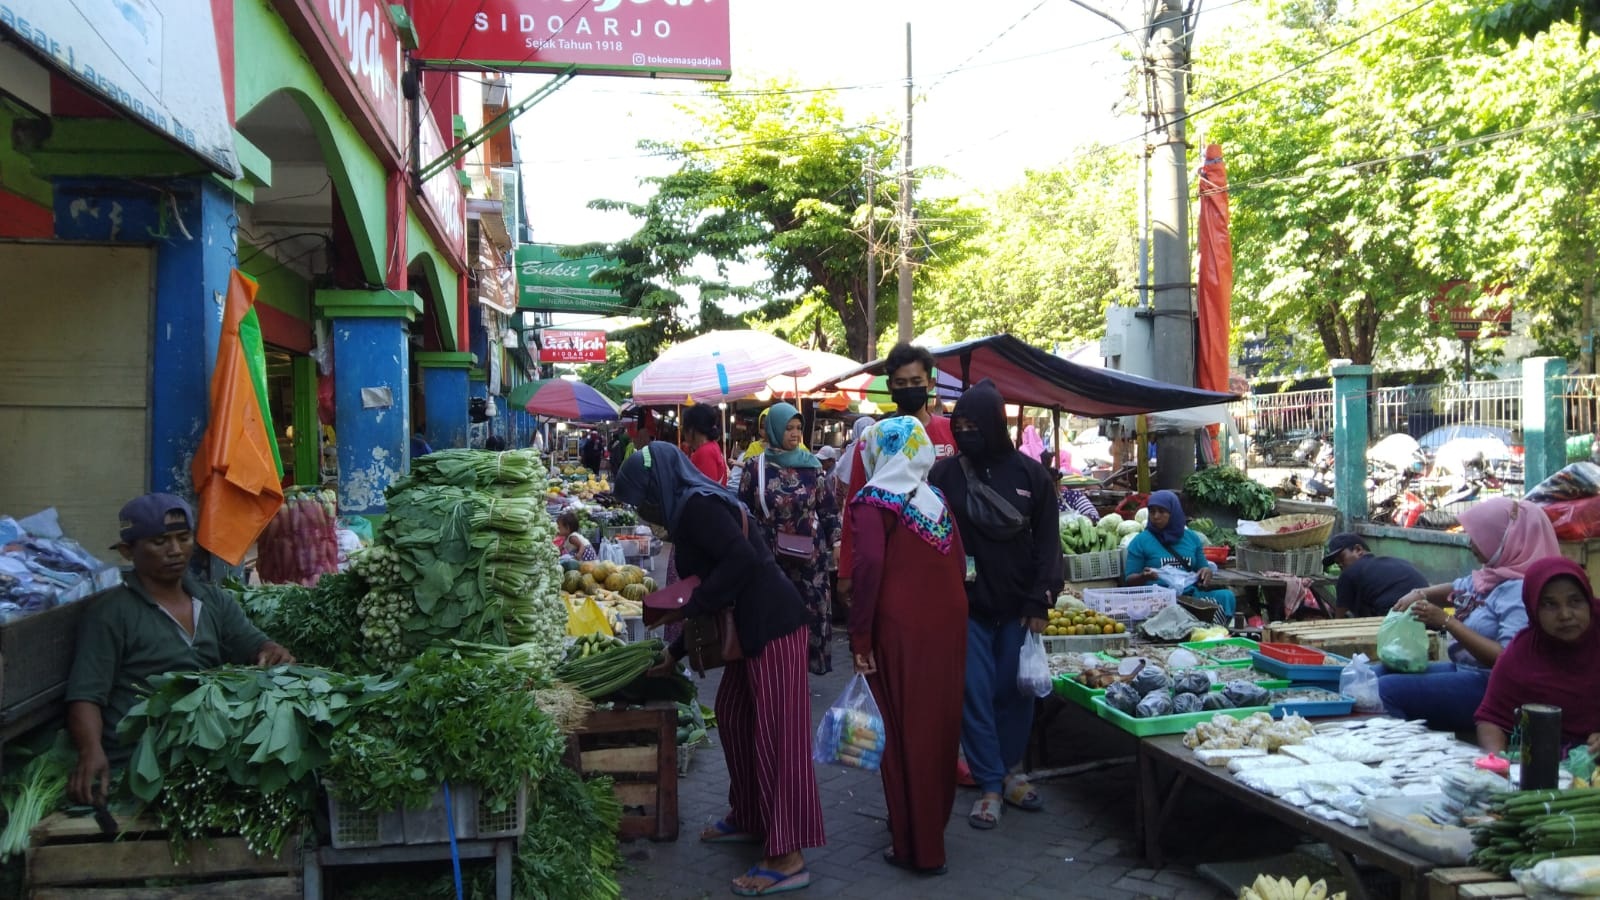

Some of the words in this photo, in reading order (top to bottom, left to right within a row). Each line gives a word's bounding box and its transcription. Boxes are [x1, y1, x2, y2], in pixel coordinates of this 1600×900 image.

[474, 12, 671, 38] SIDOARJO
[525, 37, 556, 50] Sejak
[559, 38, 593, 50] Tahun
[596, 40, 623, 51] 1918
[647, 55, 722, 66] tokoemasgadjah
[522, 261, 580, 277] Bukit
[544, 335, 604, 351] Gadjah
